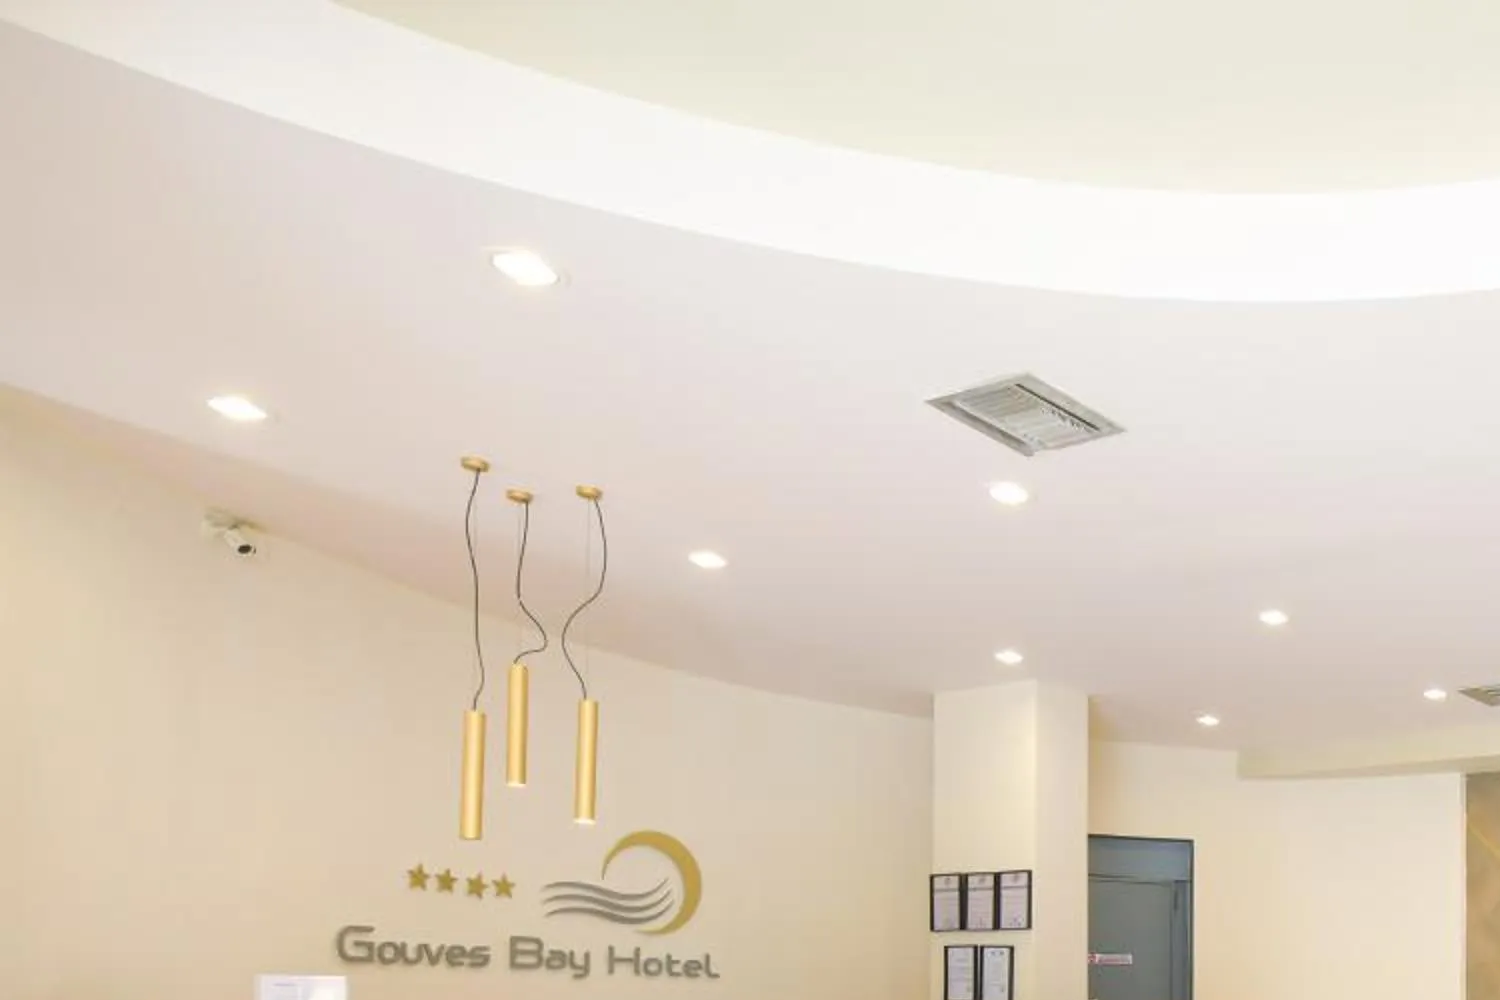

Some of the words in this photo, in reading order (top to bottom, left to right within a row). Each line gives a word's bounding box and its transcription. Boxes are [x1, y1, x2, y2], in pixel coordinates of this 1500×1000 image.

[336, 925, 491, 968] Gouves
[508, 935, 591, 979] Bay
[607, 945, 721, 979] Hotel
